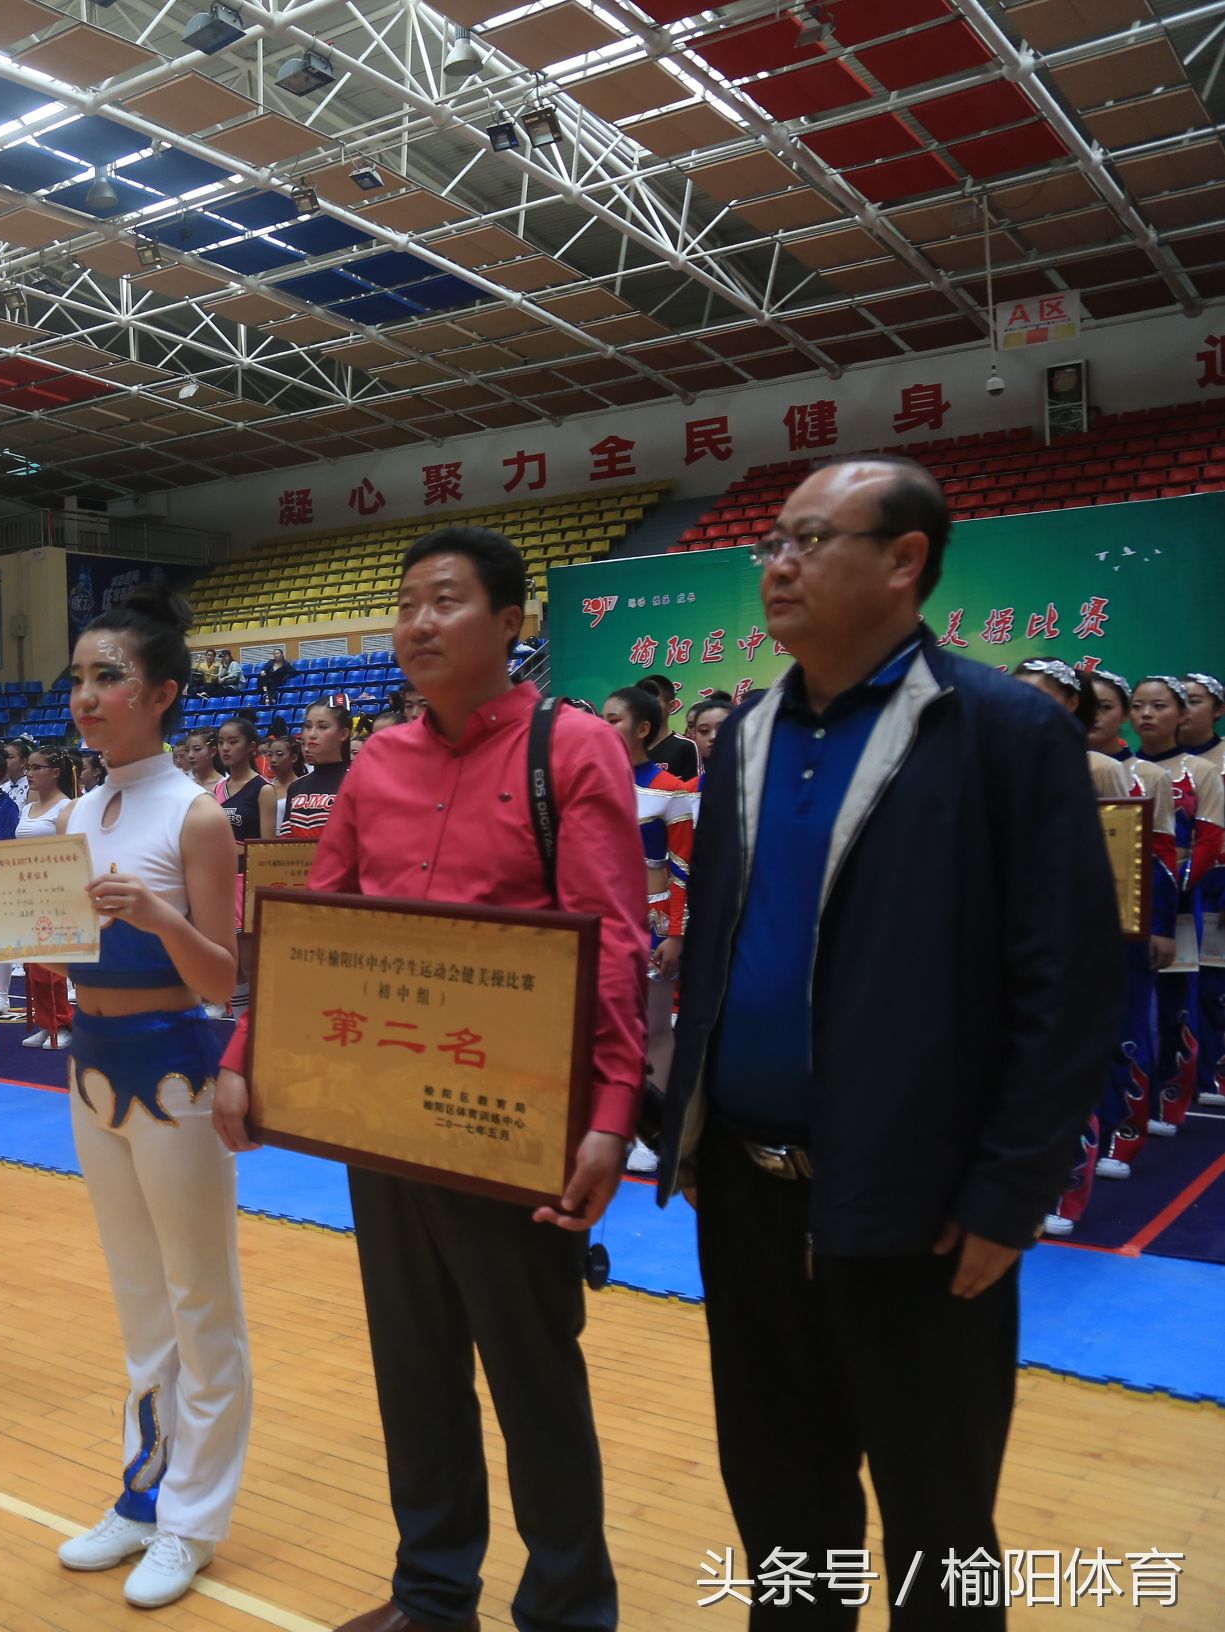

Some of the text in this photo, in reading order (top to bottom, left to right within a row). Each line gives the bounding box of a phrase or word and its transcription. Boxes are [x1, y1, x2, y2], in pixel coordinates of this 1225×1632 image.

[278, 382, 952, 527] 凝心聚力全民健身
[534, 769, 546, 798] EOS
[322, 1007, 487, 1070] 第二名
